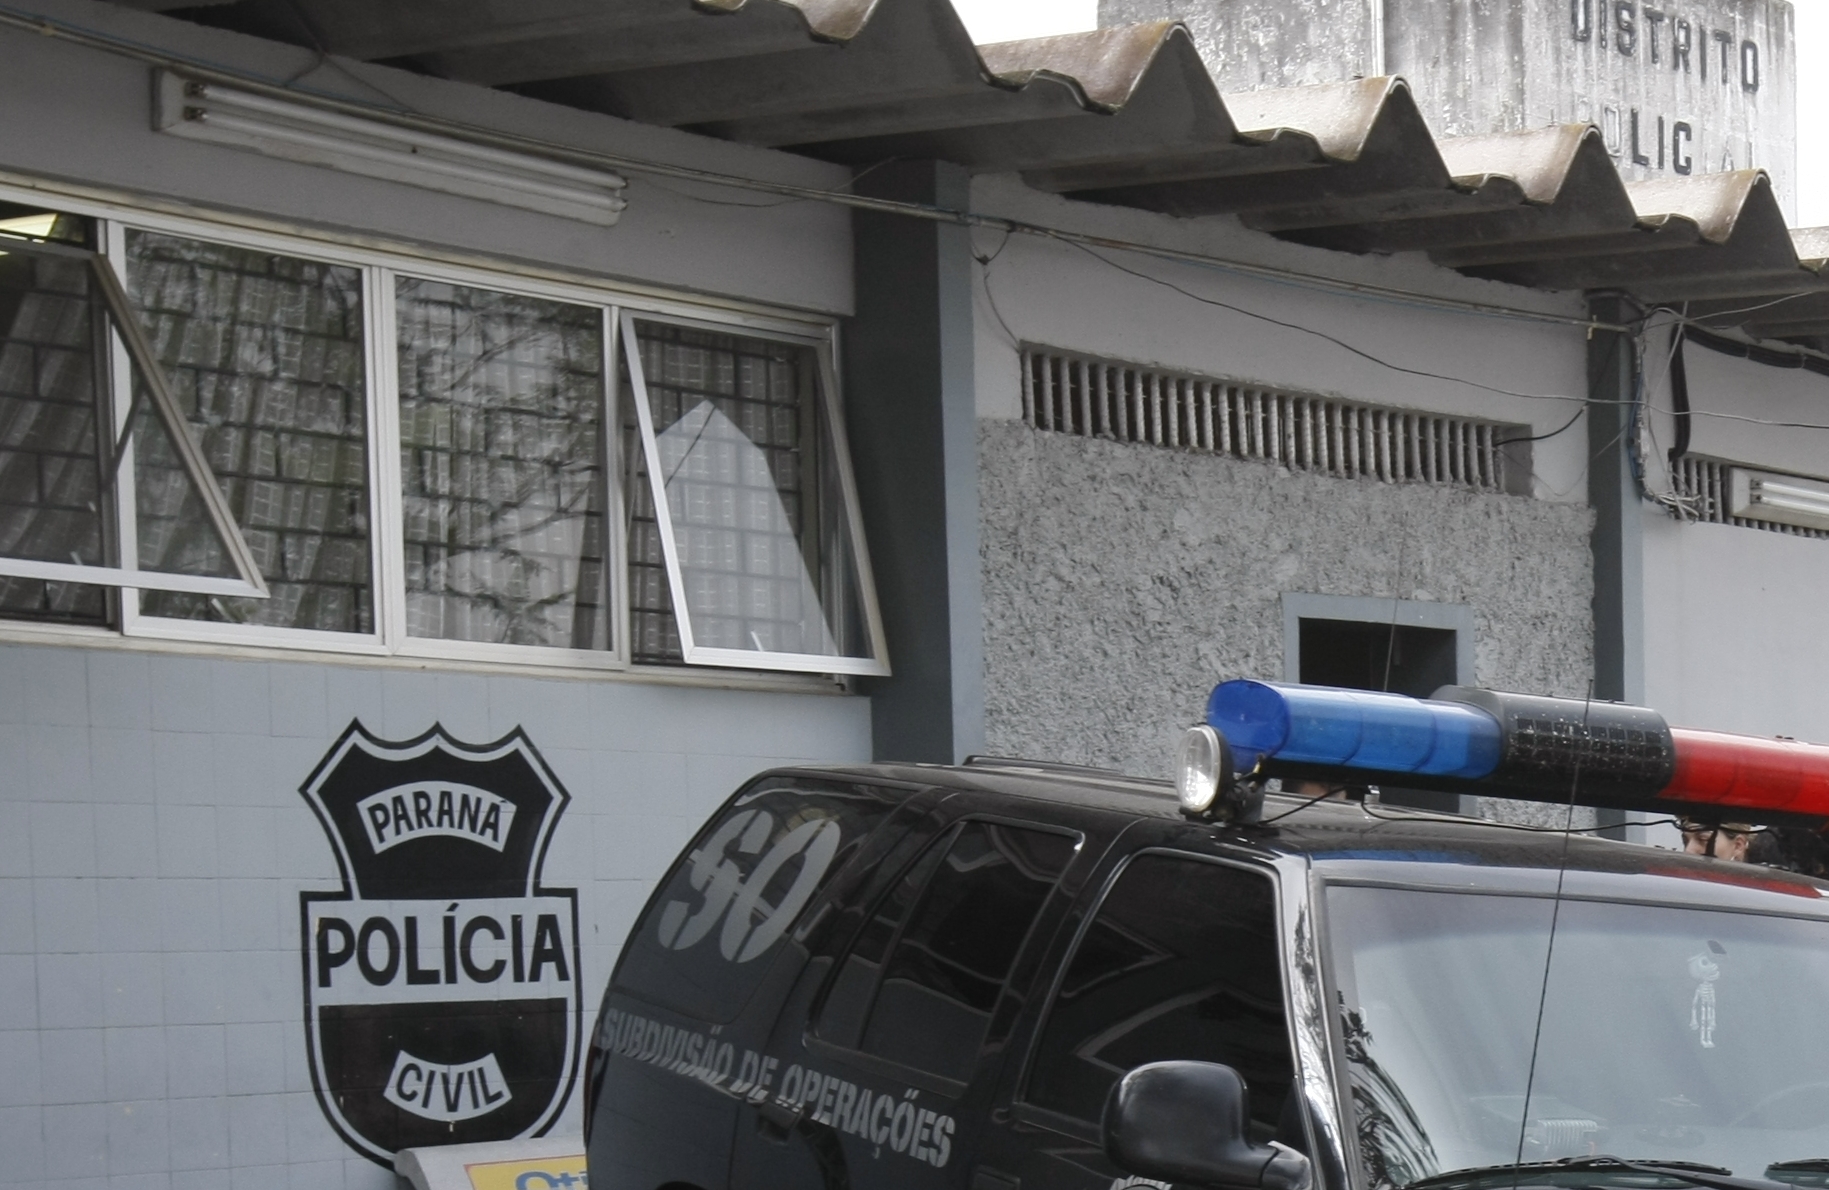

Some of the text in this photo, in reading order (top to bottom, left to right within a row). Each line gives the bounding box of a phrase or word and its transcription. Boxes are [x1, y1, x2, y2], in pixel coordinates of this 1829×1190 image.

[318, 903, 569, 987] POLÍCIA
[396, 1063, 504, 1112] CIVIL
[729, 1050, 779, 1104] DE
